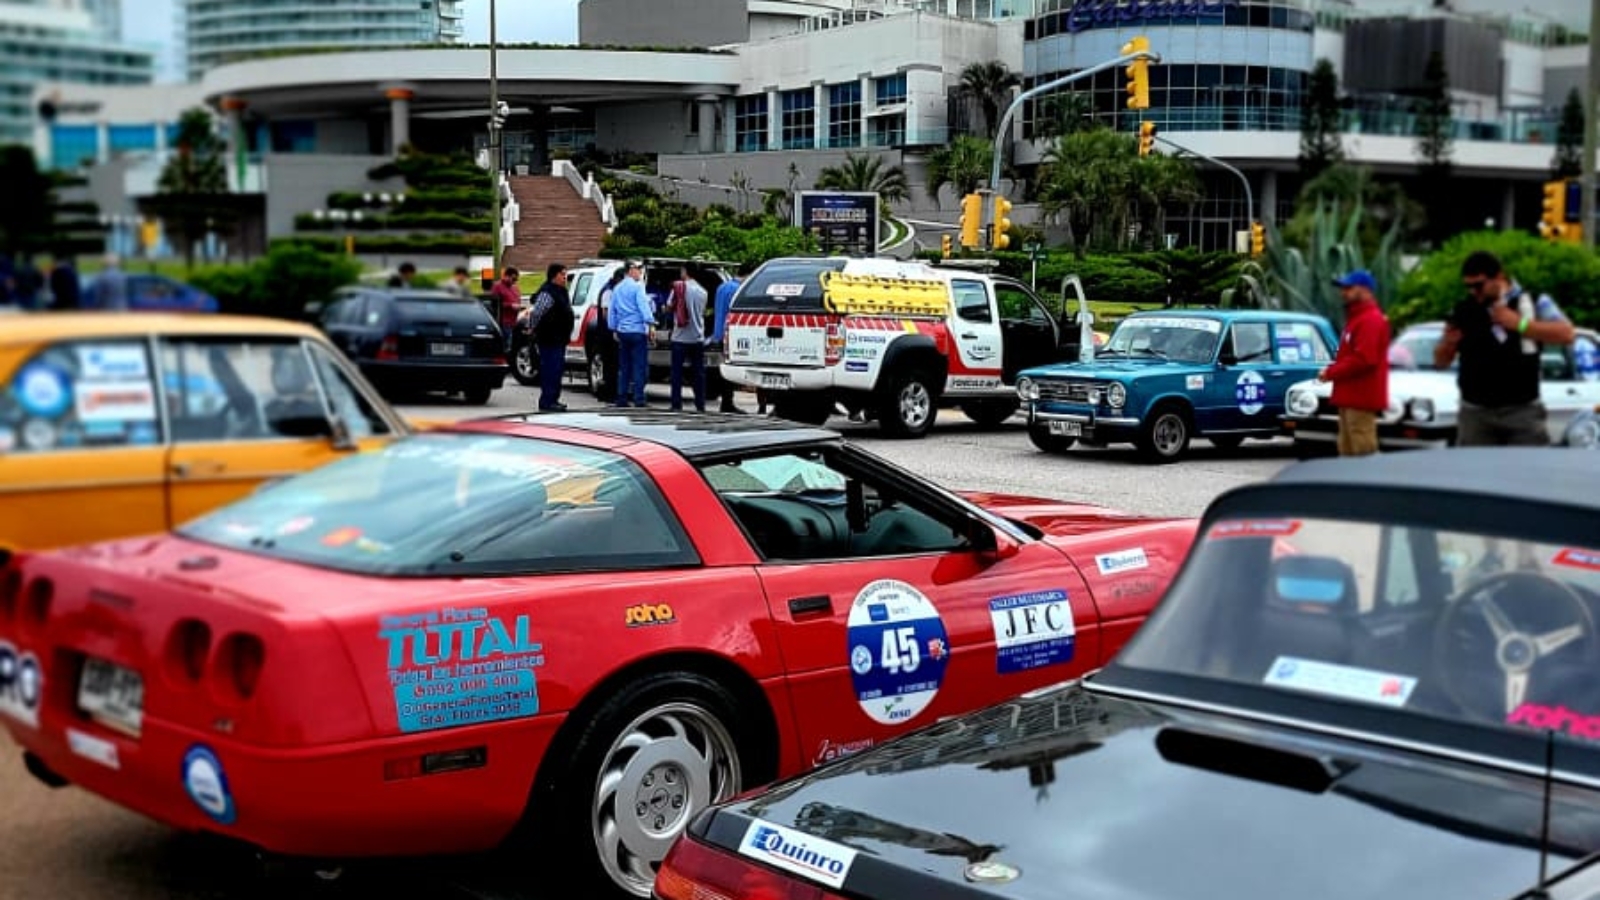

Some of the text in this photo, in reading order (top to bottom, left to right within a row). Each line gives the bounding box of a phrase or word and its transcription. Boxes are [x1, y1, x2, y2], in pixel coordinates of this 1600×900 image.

[378, 614, 543, 669] TOTAL
[881, 627, 921, 675] 45
[757, 827, 844, 875] Quinro
